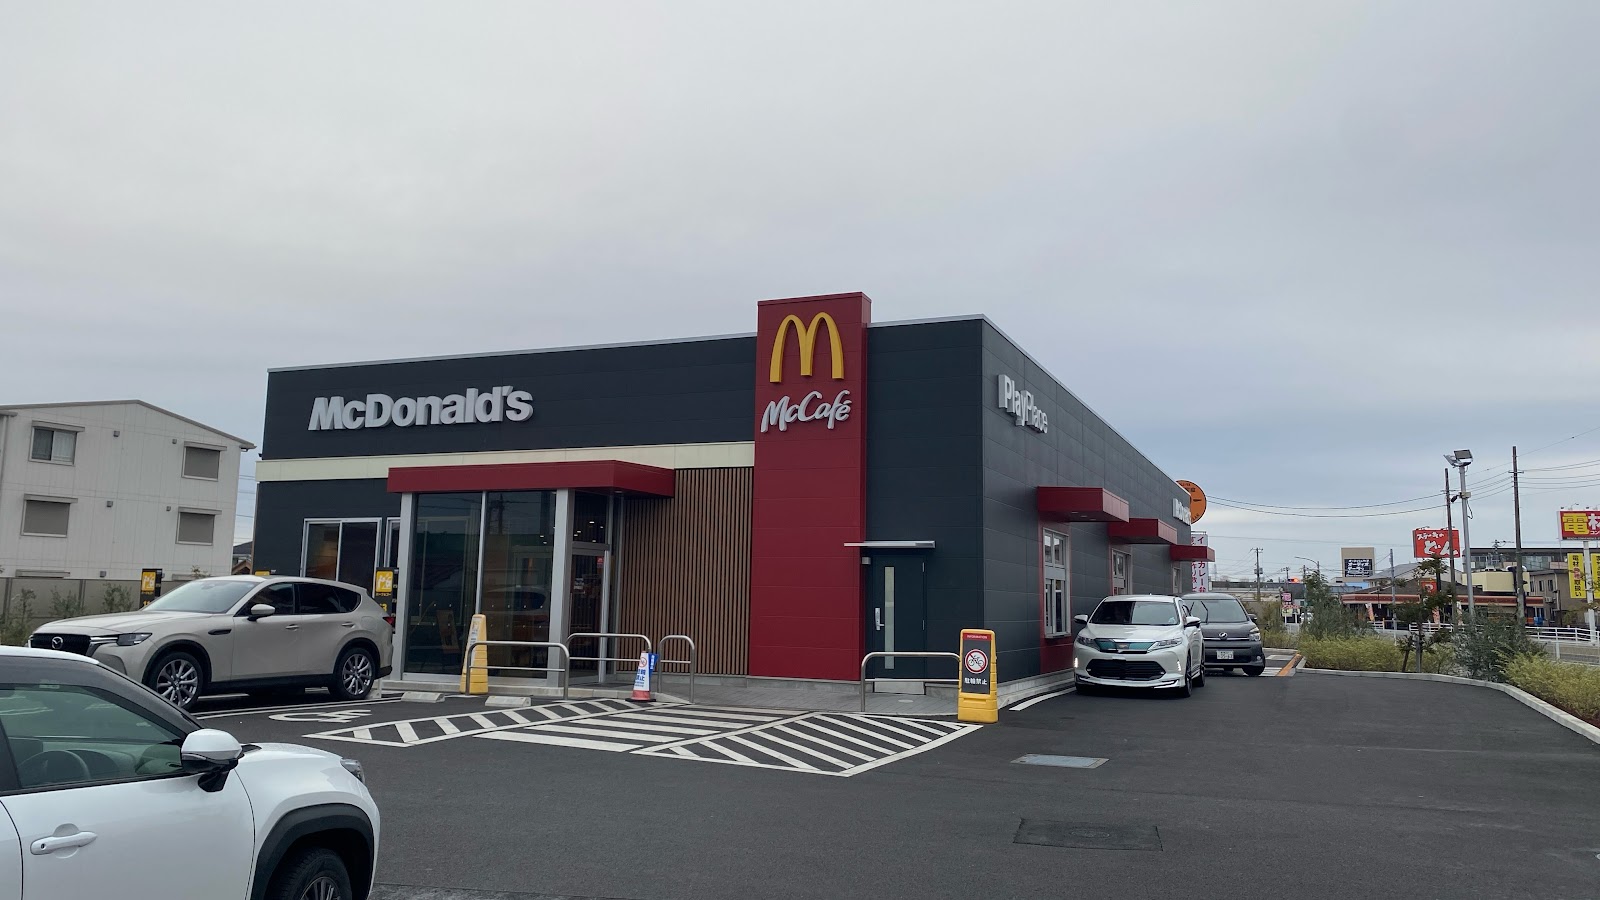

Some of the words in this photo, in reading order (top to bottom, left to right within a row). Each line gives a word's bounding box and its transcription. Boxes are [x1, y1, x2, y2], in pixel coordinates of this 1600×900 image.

[308, 386, 533, 430] McDonald's
[760, 390, 852, 432] McCafé
[998, 374, 1048, 433] PlayPlace
[1423, 540, 1459, 556] どん
